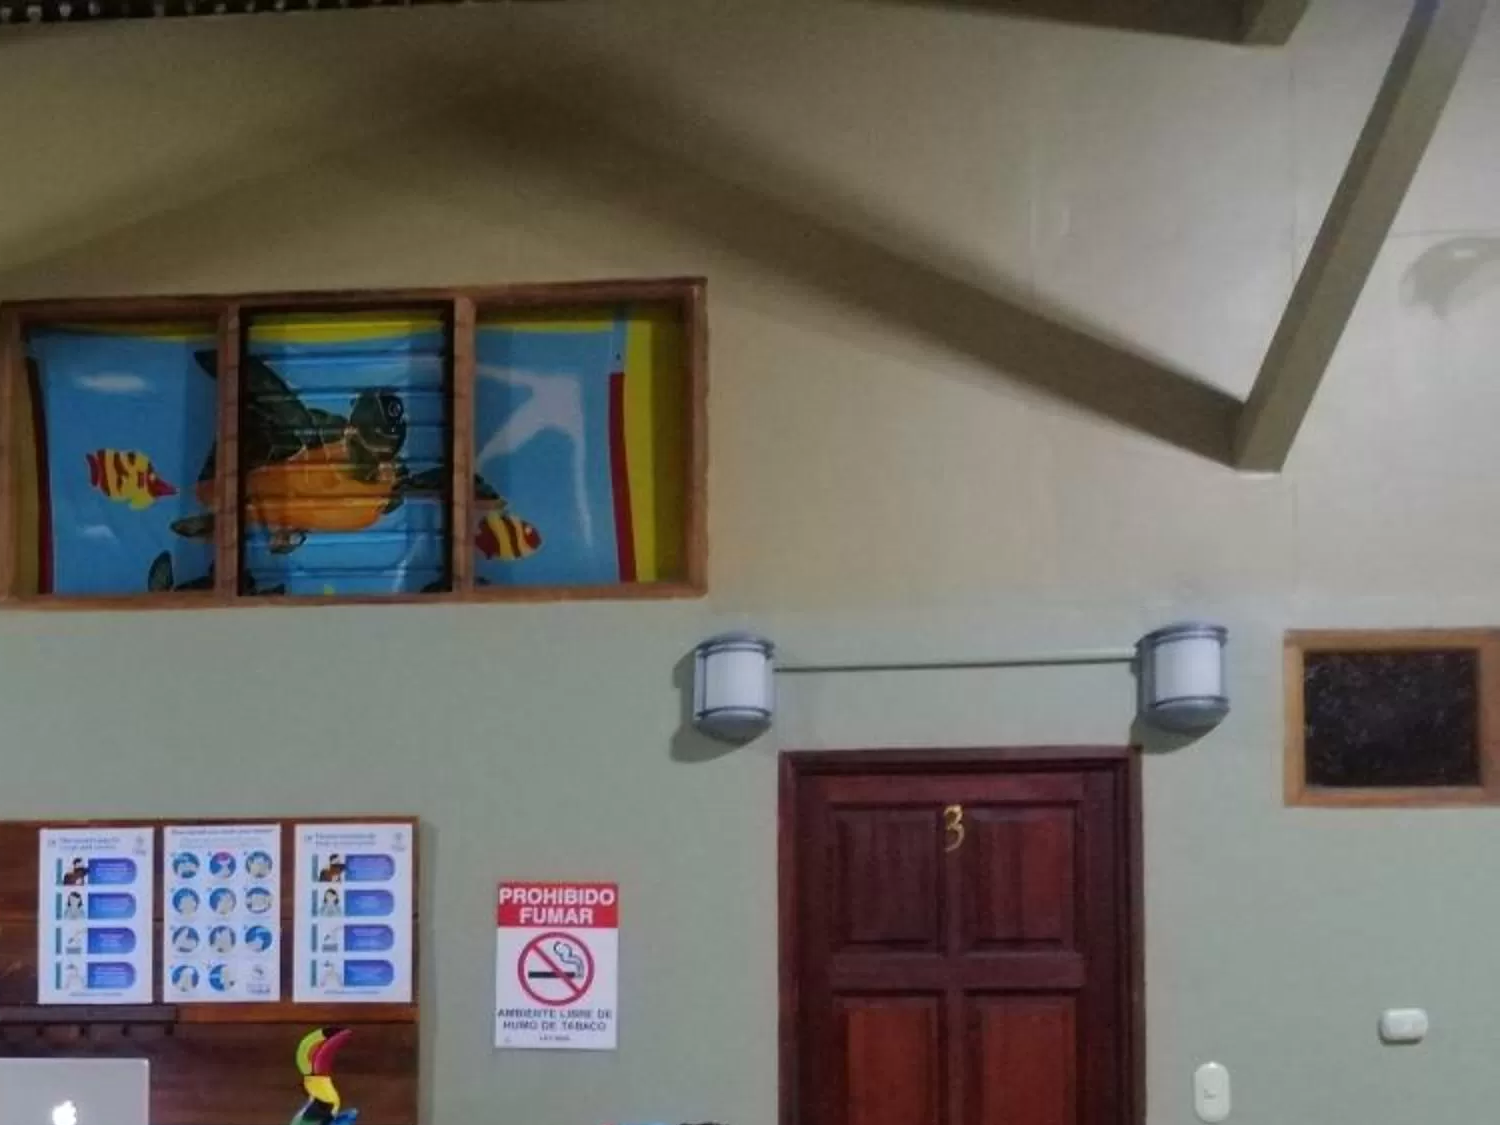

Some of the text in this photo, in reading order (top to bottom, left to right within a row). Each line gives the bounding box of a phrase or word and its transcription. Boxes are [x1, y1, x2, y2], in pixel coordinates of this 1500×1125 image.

[943, 805, 965, 853] 3
[499, 887, 616, 906] PROHIBIDO
[519, 907, 594, 925] FUMAR
[498, 1008, 612, 1019] AMBIENTE LIBRE DE
[503, 1021, 607, 1032] HUMO DE TABACO
